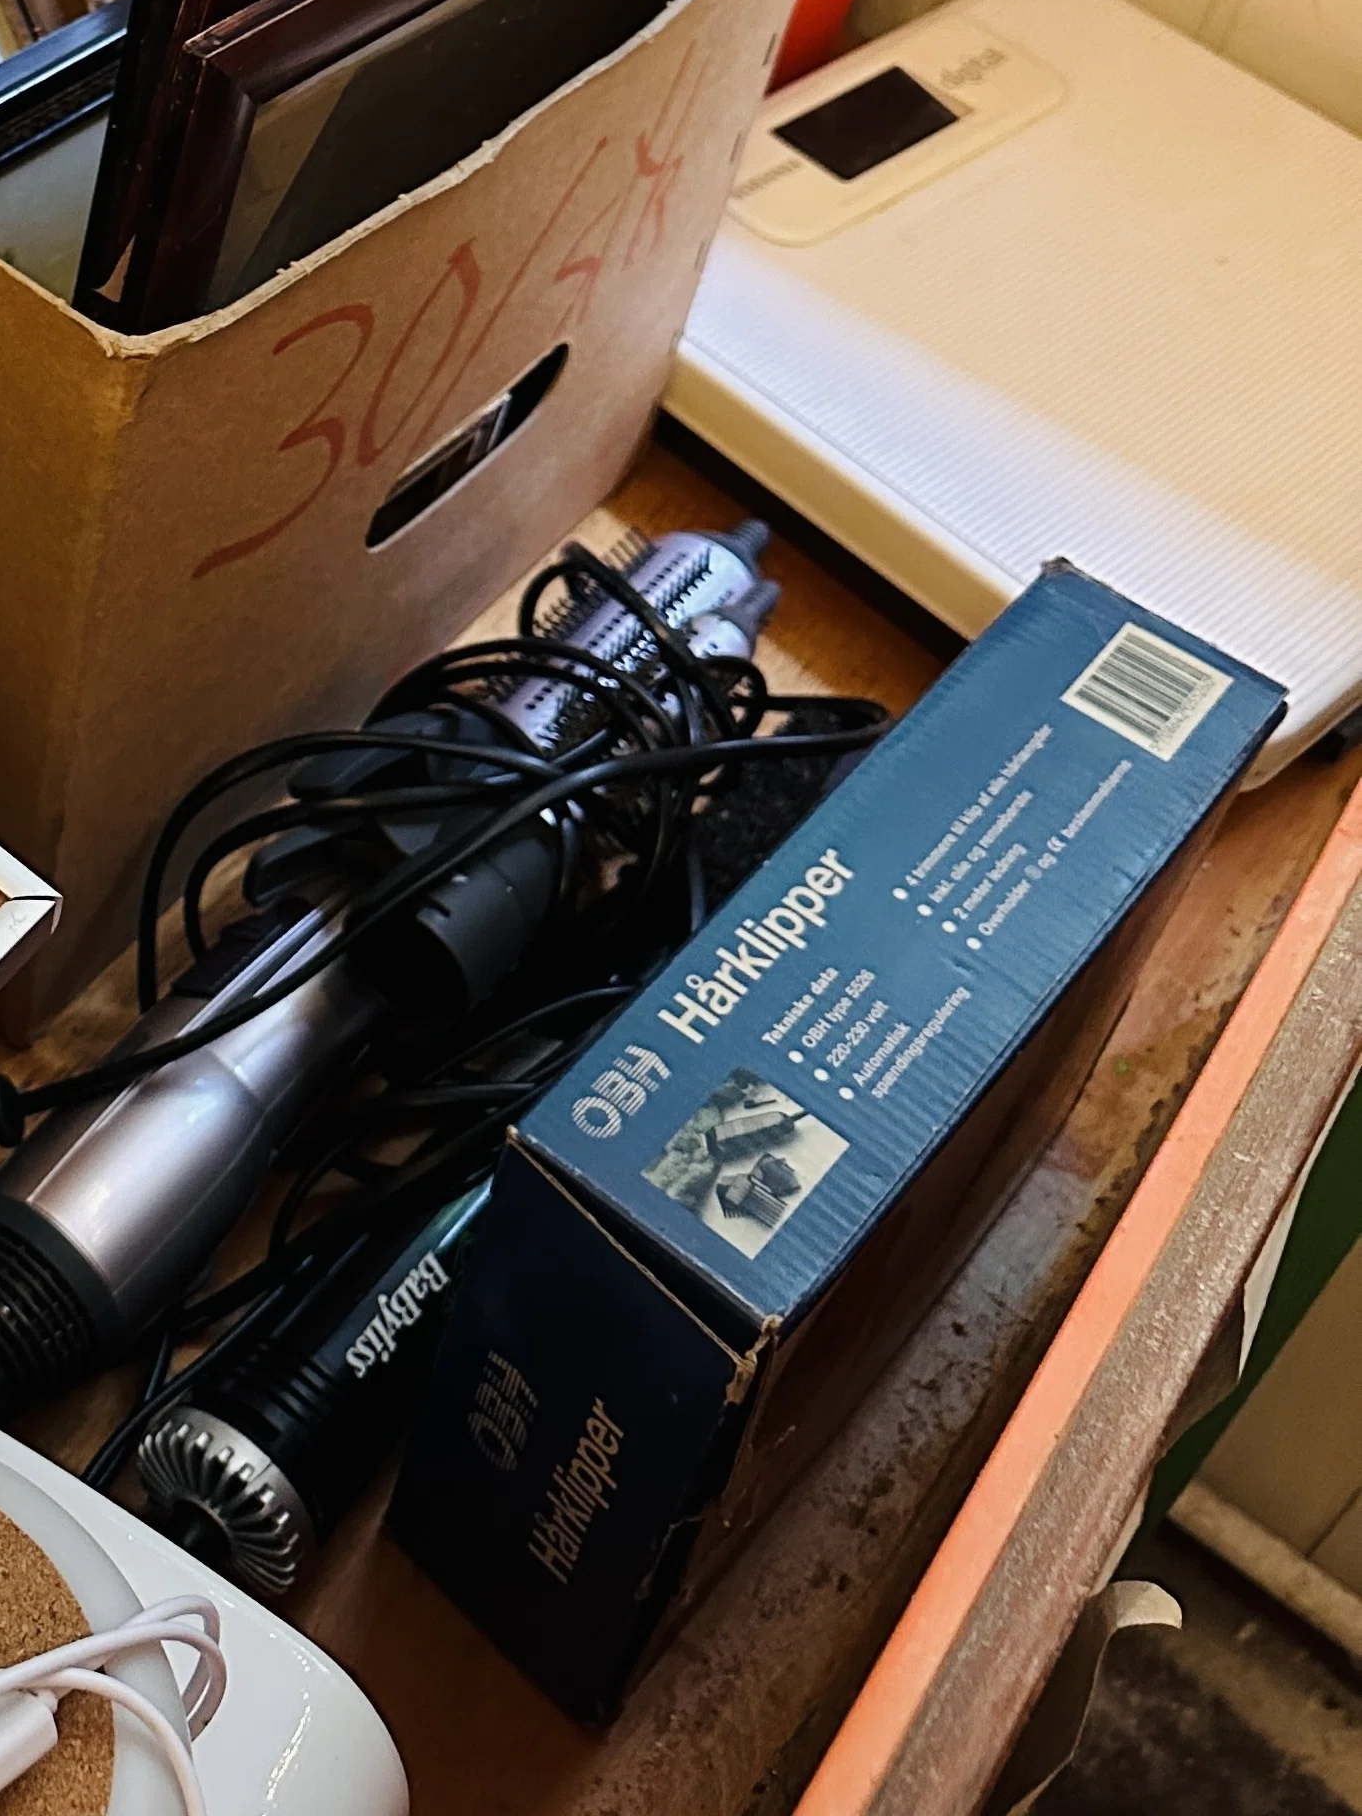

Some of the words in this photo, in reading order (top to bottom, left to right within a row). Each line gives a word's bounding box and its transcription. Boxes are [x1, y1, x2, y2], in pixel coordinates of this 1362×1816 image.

[951, 904, 969, 921] 2
[975, 878, 1031, 937] Overholder
[574, 1041, 670, 1133] OBH
[656, 846, 852, 1043] Hårklipper
[761, 991, 815, 1046] Tekniske
[807, 965, 839, 996] data
[799, 1017, 832, 1050] OBH
[825, 995, 853, 1023] type
[843, 967, 876, 999] 5526
[825, 1020, 870, 1068] 220-230
[863, 999, 889, 1023] volt
[854, 1019, 910, 1087] Automatisk
[869, 984, 970, 1100] spændingsregulering
[343, 1249, 449, 1378] BaByliss
[527, 1397, 624, 1585] Hårklipper
